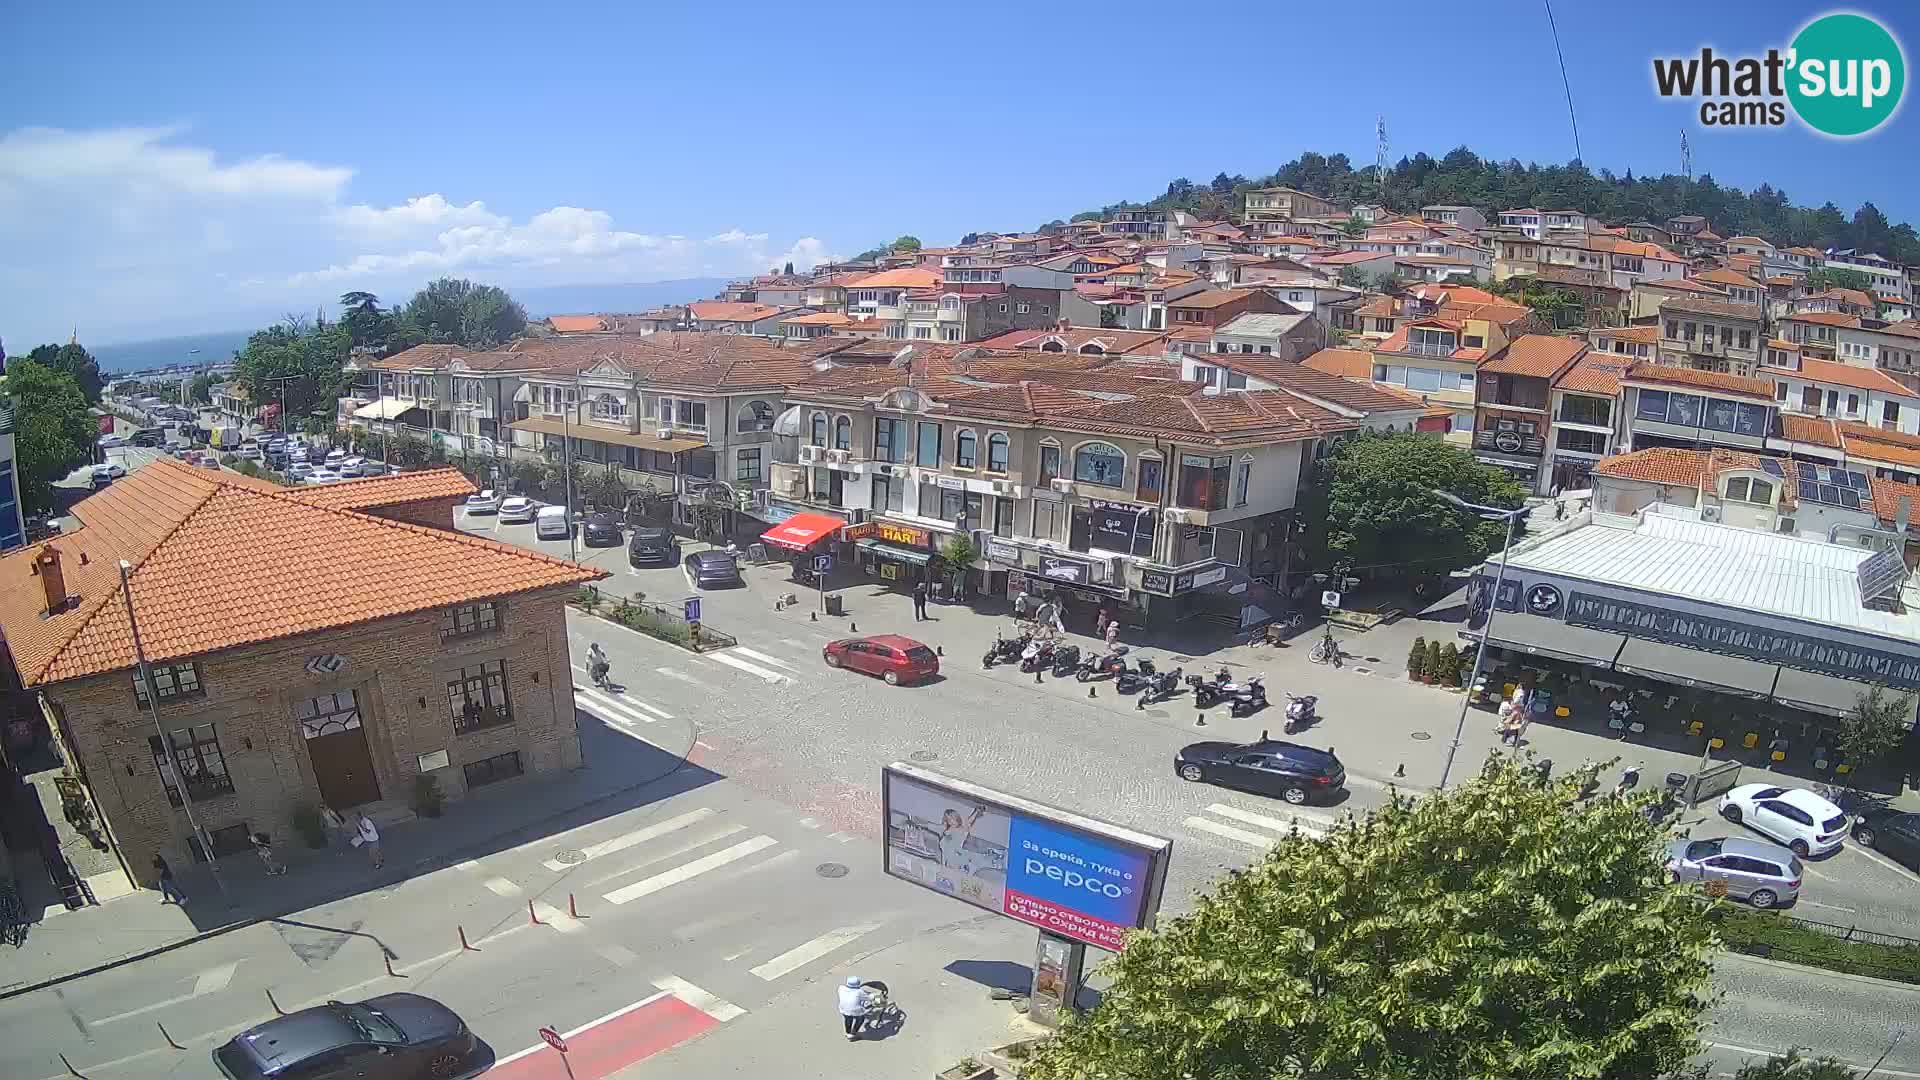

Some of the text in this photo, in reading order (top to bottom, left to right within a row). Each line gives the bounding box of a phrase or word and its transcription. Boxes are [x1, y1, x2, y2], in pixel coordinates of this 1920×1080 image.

[1022, 840, 1039, 852] За
[1088, 861, 1121, 877] тука
[1123, 872, 1132, 880] е
[1010, 903, 1047, 919] 02.07
[542, 1031, 565, 1049] STOP
